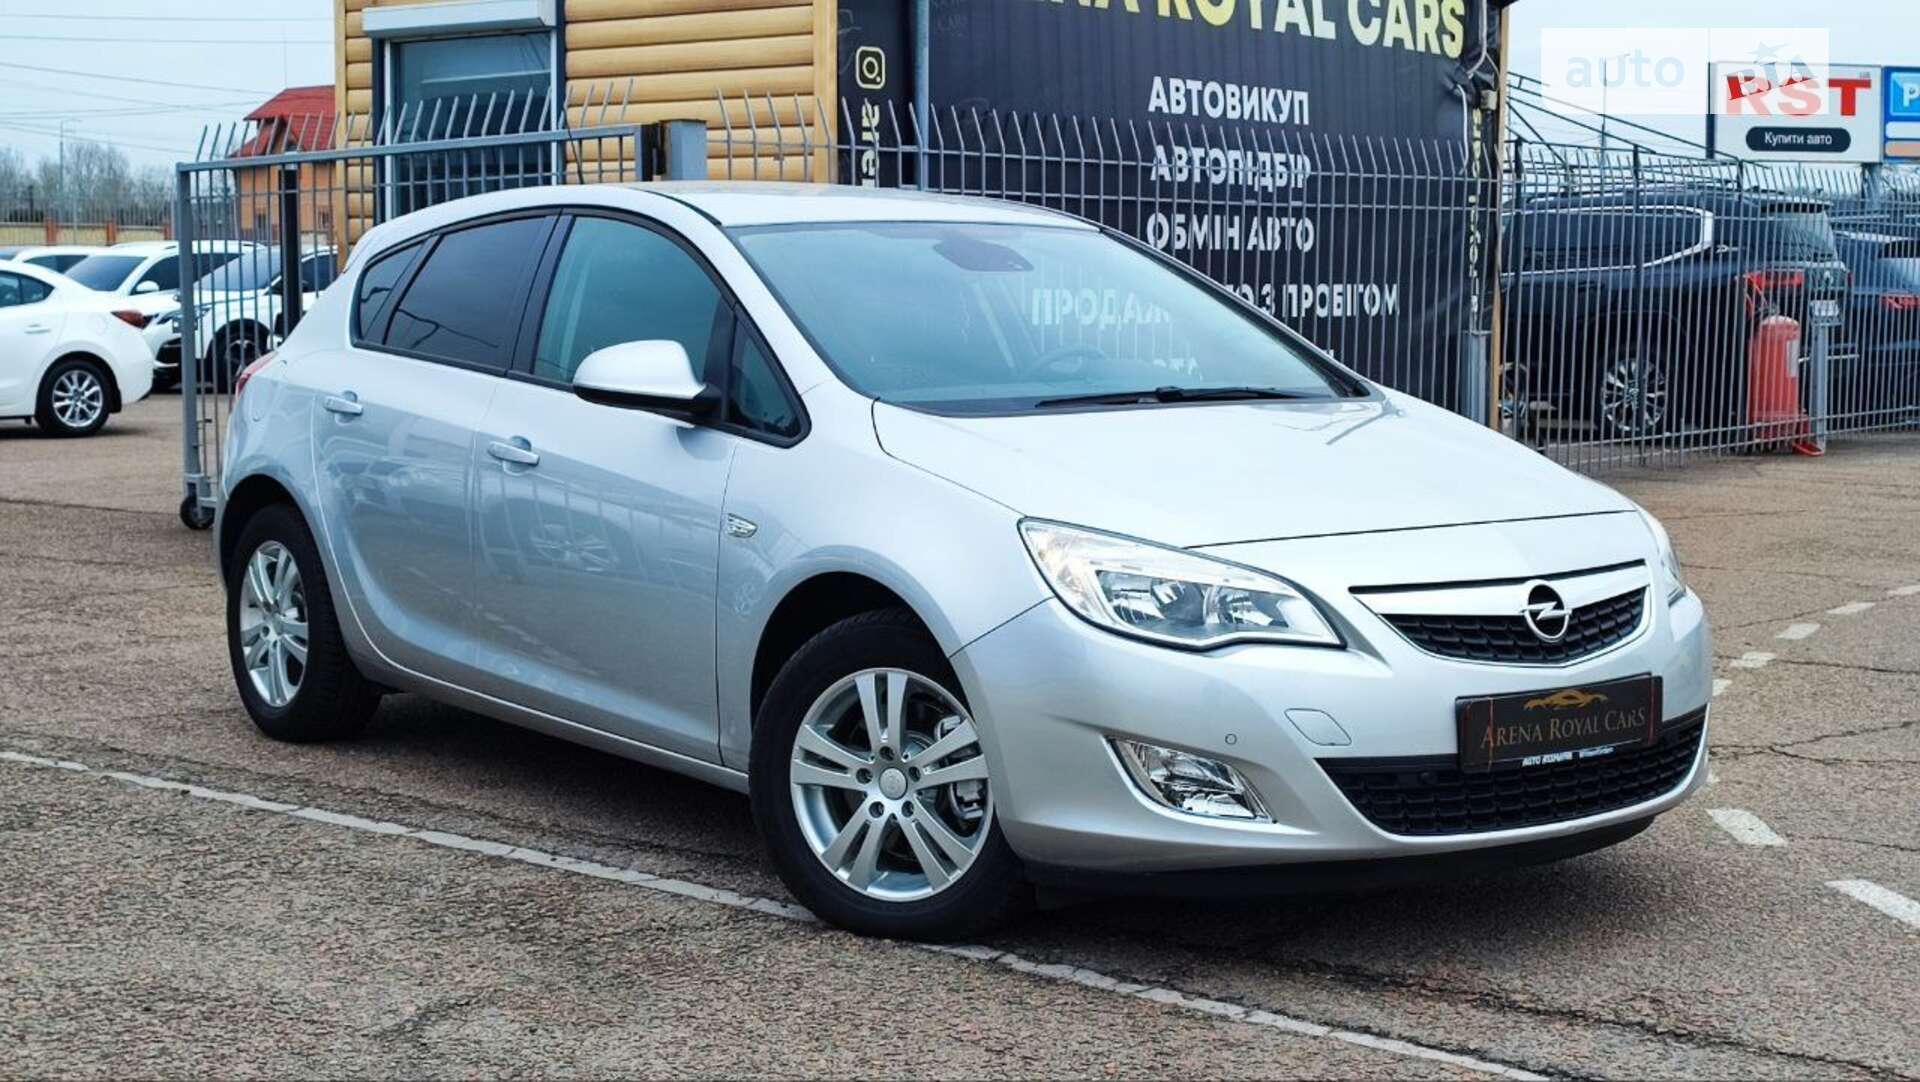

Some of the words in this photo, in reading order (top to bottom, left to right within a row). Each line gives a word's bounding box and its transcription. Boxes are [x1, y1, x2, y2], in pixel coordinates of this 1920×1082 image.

[1348, 0, 1465, 58] CARS
[1147, 76, 1310, 126] АВТОВИКУП
[1726, 76, 1871, 117] RST
[1764, 131, 1803, 148] Купити
[1806, 133, 1833, 145] авто
[1150, 145, 1312, 193] АВТОПІДБІР
[1146, 212, 1240, 251] ОБМІН
[1246, 215, 1315, 253] АВТО
[1281, 283, 1400, 319] ПРОБІГОМ
[1480, 723, 1543, 749] ARENA
[1549, 713, 1600, 741] ROYAL
[1604, 707, 1646, 732] CARS
